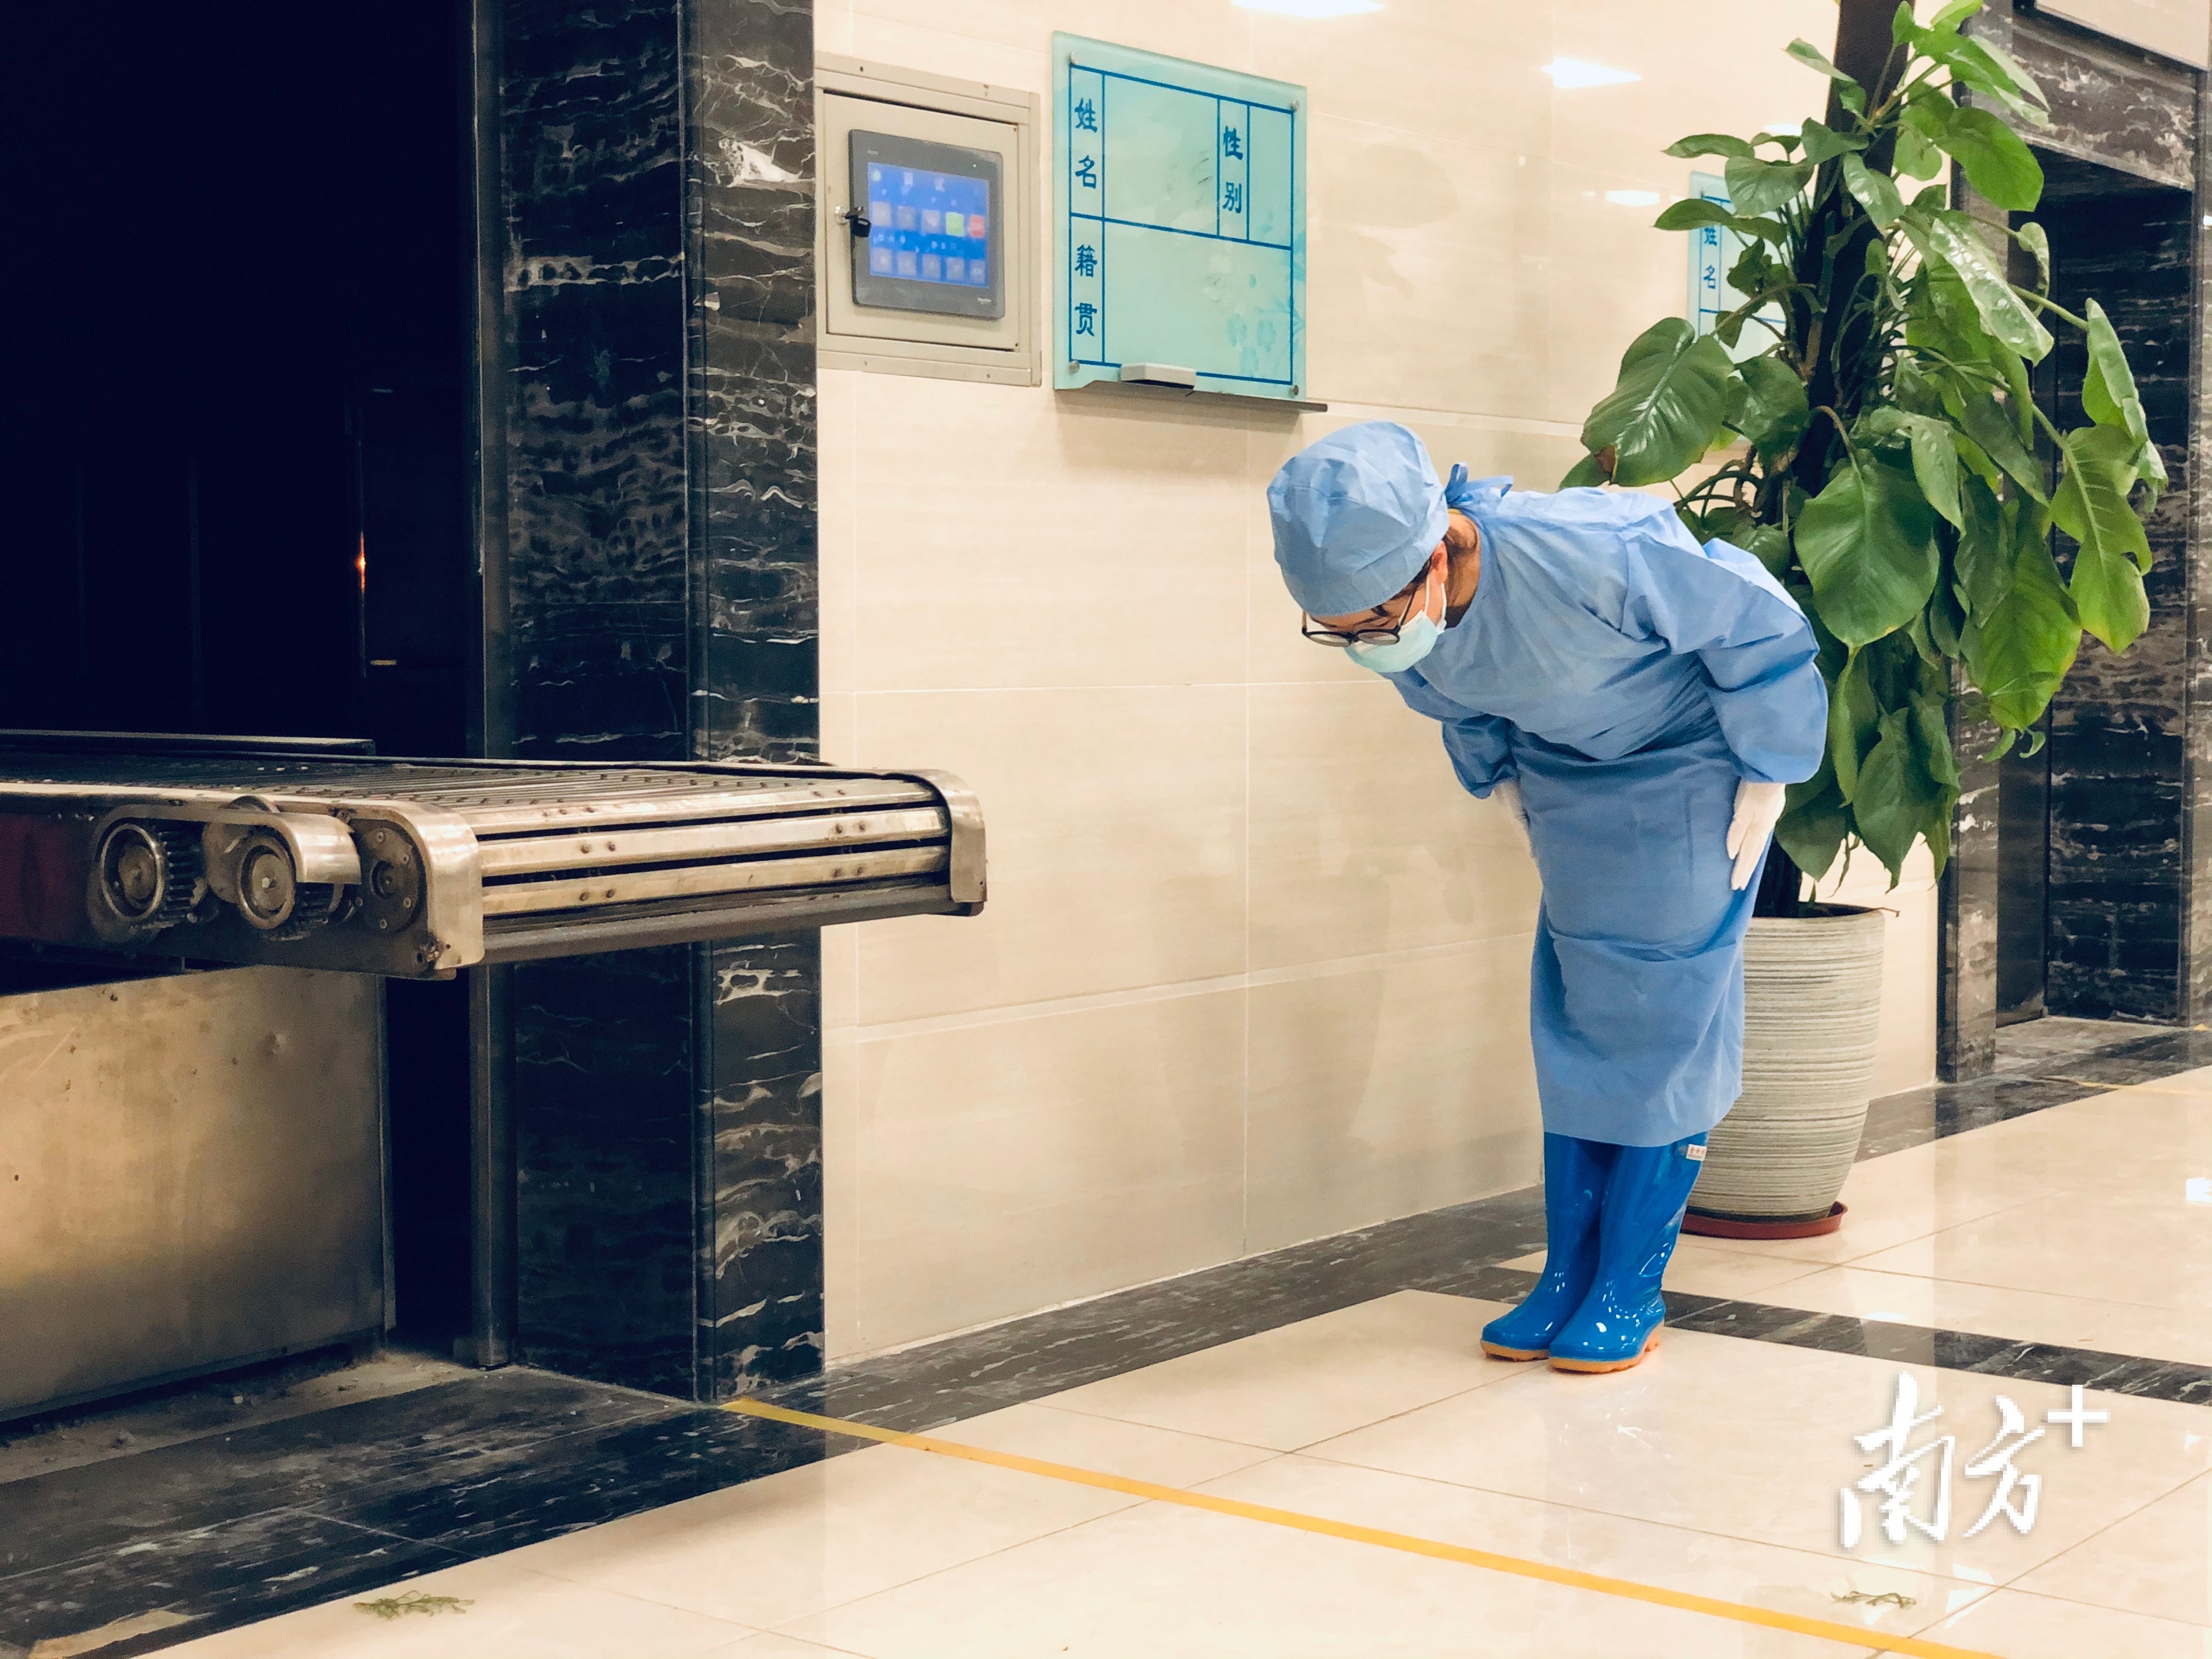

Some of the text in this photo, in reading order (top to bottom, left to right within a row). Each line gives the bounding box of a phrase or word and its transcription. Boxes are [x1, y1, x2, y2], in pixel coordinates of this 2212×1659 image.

[1074, 97, 1098, 190] 姓名
[1222, 125, 1244, 215] 性别
[1074, 243, 1098, 337] 籍贯
